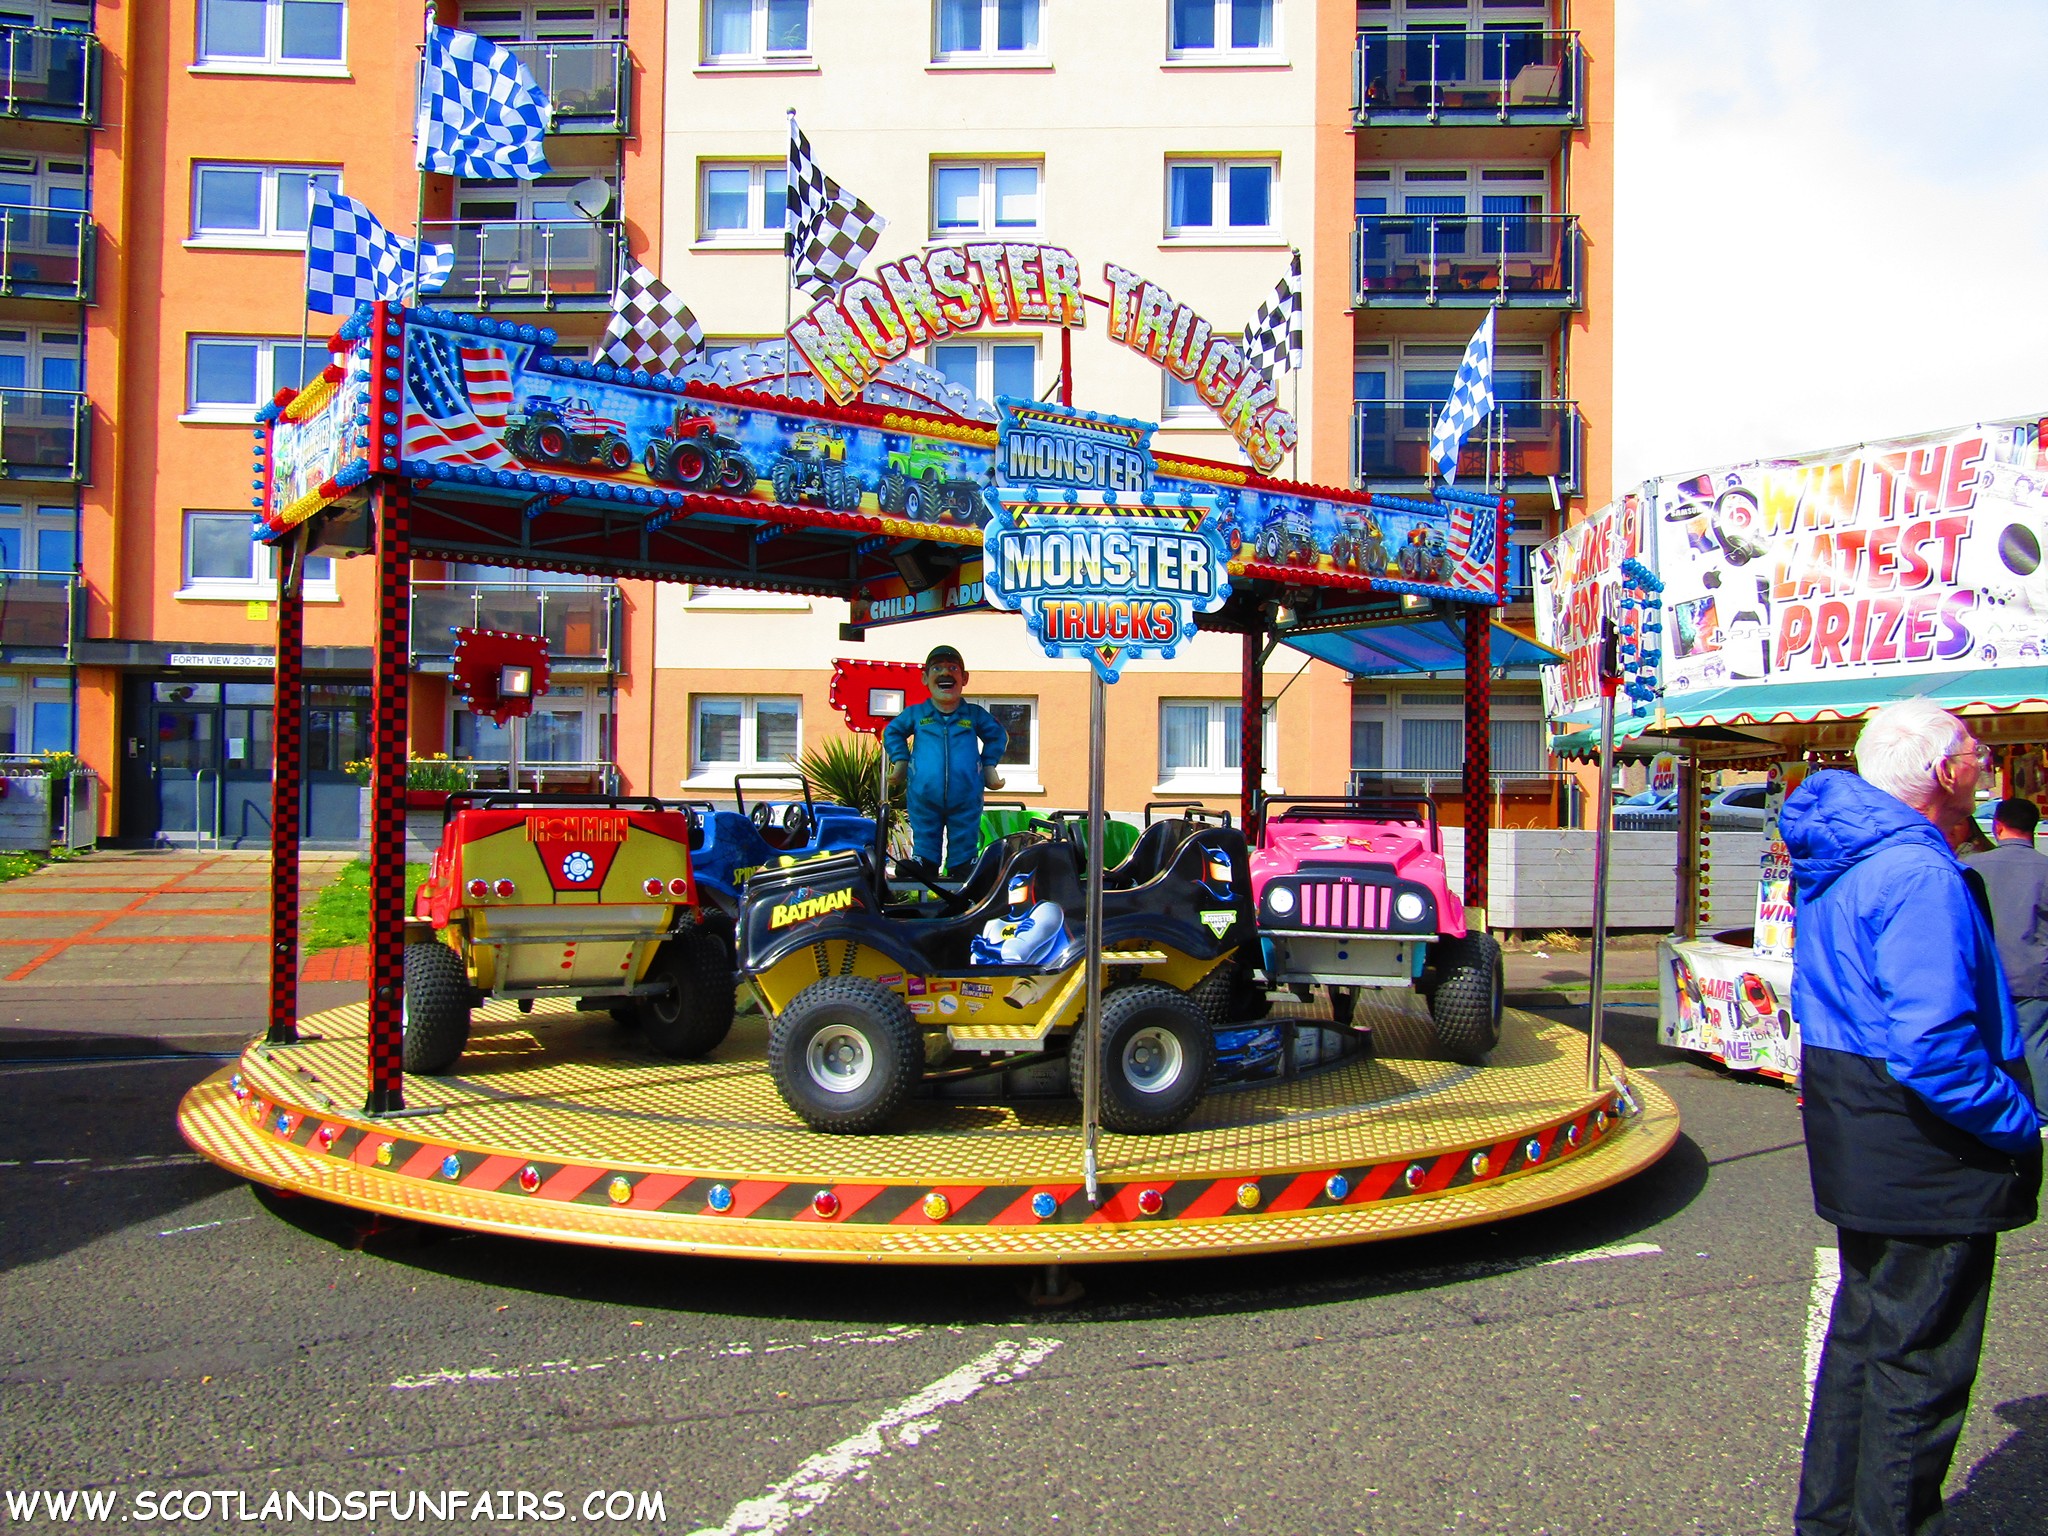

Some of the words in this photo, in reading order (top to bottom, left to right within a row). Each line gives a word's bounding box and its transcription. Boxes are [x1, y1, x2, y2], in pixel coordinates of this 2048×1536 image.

[786, 241, 1087, 407] MONSTER
[1103, 262, 1298, 476] TRUCKS
[1009, 434, 1145, 492] MONSTER
[1762, 458, 1866, 536] WIN
[1871, 437, 1988, 522] THE
[1003, 533, 1209, 594] MONSTER
[1772, 515, 1973, 603] LATEST
[945, 580, 987, 608] ADU
[1571, 580, 1600, 645] FOR
[1043, 601, 1175, 640] TRUCKS
[1730, 628, 1771, 641] PS5
[1774, 589, 1980, 672] PRIZES
[173, 656, 204, 664] FORTH
[208, 657, 231, 665] VIEW
[1653, 772, 1675, 790] CASH
[525, 816, 580, 841] IRON
[582, 816, 629, 841] MAN
[770, 888, 853, 930] BATMAN
[1760, 904, 1796, 921] WIN
[1698, 977, 1735, 1001] GAME
